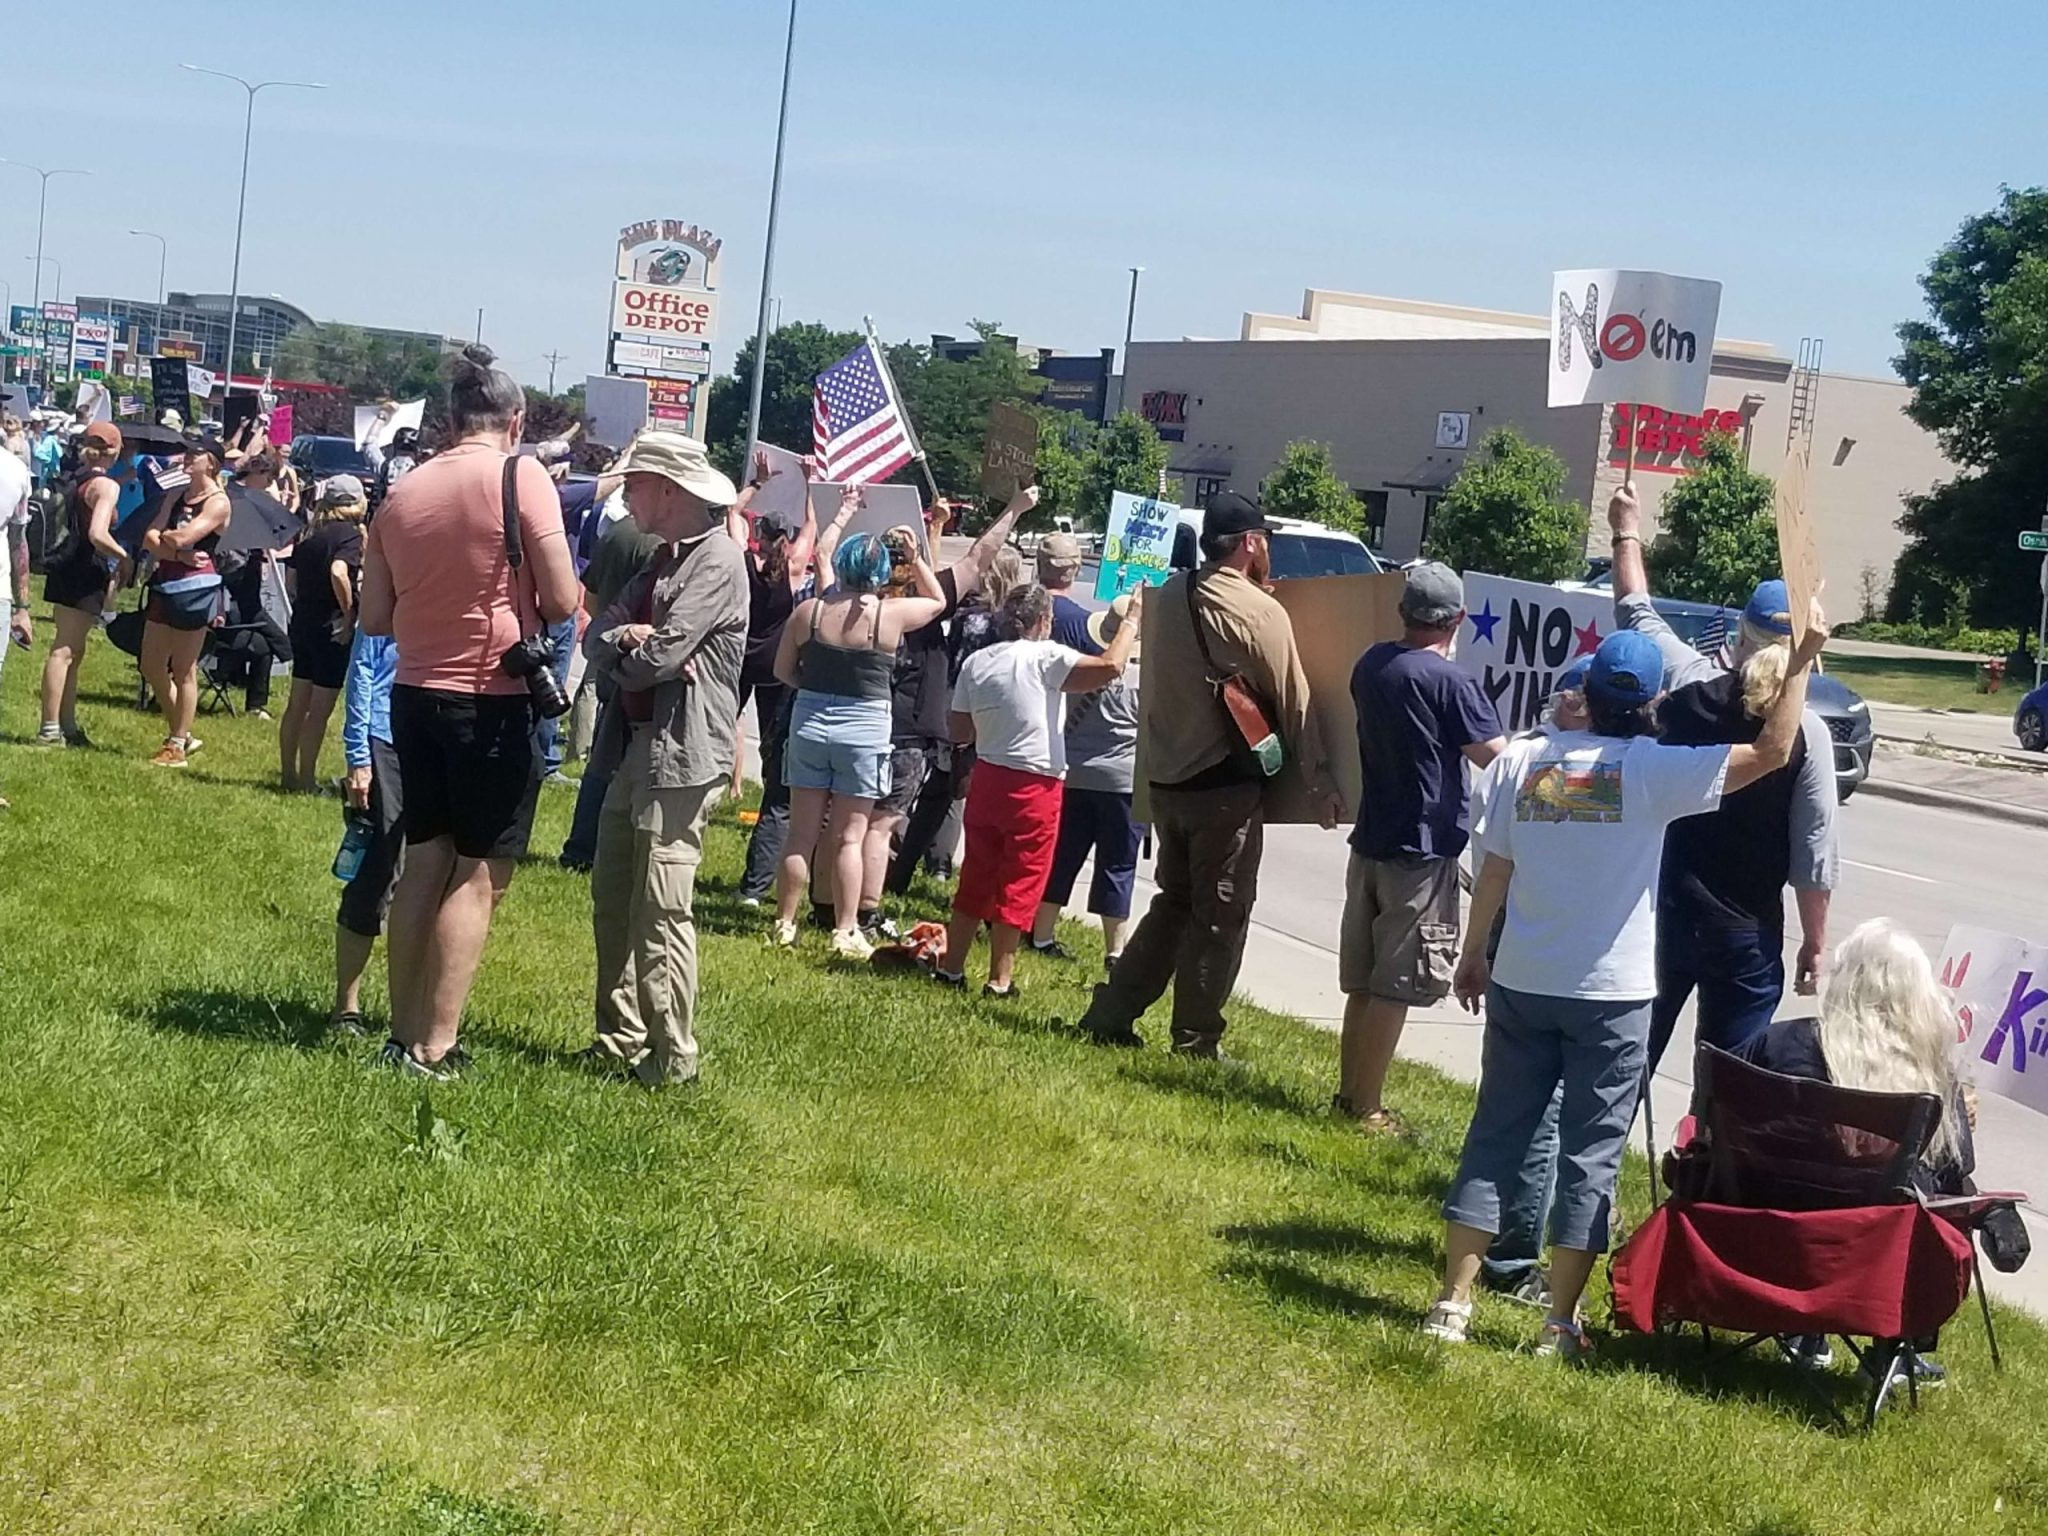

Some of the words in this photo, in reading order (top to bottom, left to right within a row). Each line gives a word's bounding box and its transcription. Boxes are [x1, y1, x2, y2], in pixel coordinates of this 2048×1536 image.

[620, 220, 658, 251] THE
[661, 220, 722, 263] PLAZA
[624, 290, 710, 319] Office
[625, 312, 706, 335] DEPOT
[988, 453, 1022, 476] LAND
[1004, 444, 1035, 467] STOLE
[1131, 501, 1169, 523] SHOW
[1129, 537, 1152, 552] FOR
[1505, 598, 1573, 668] NO
[1483, 665, 1564, 731] KIN
